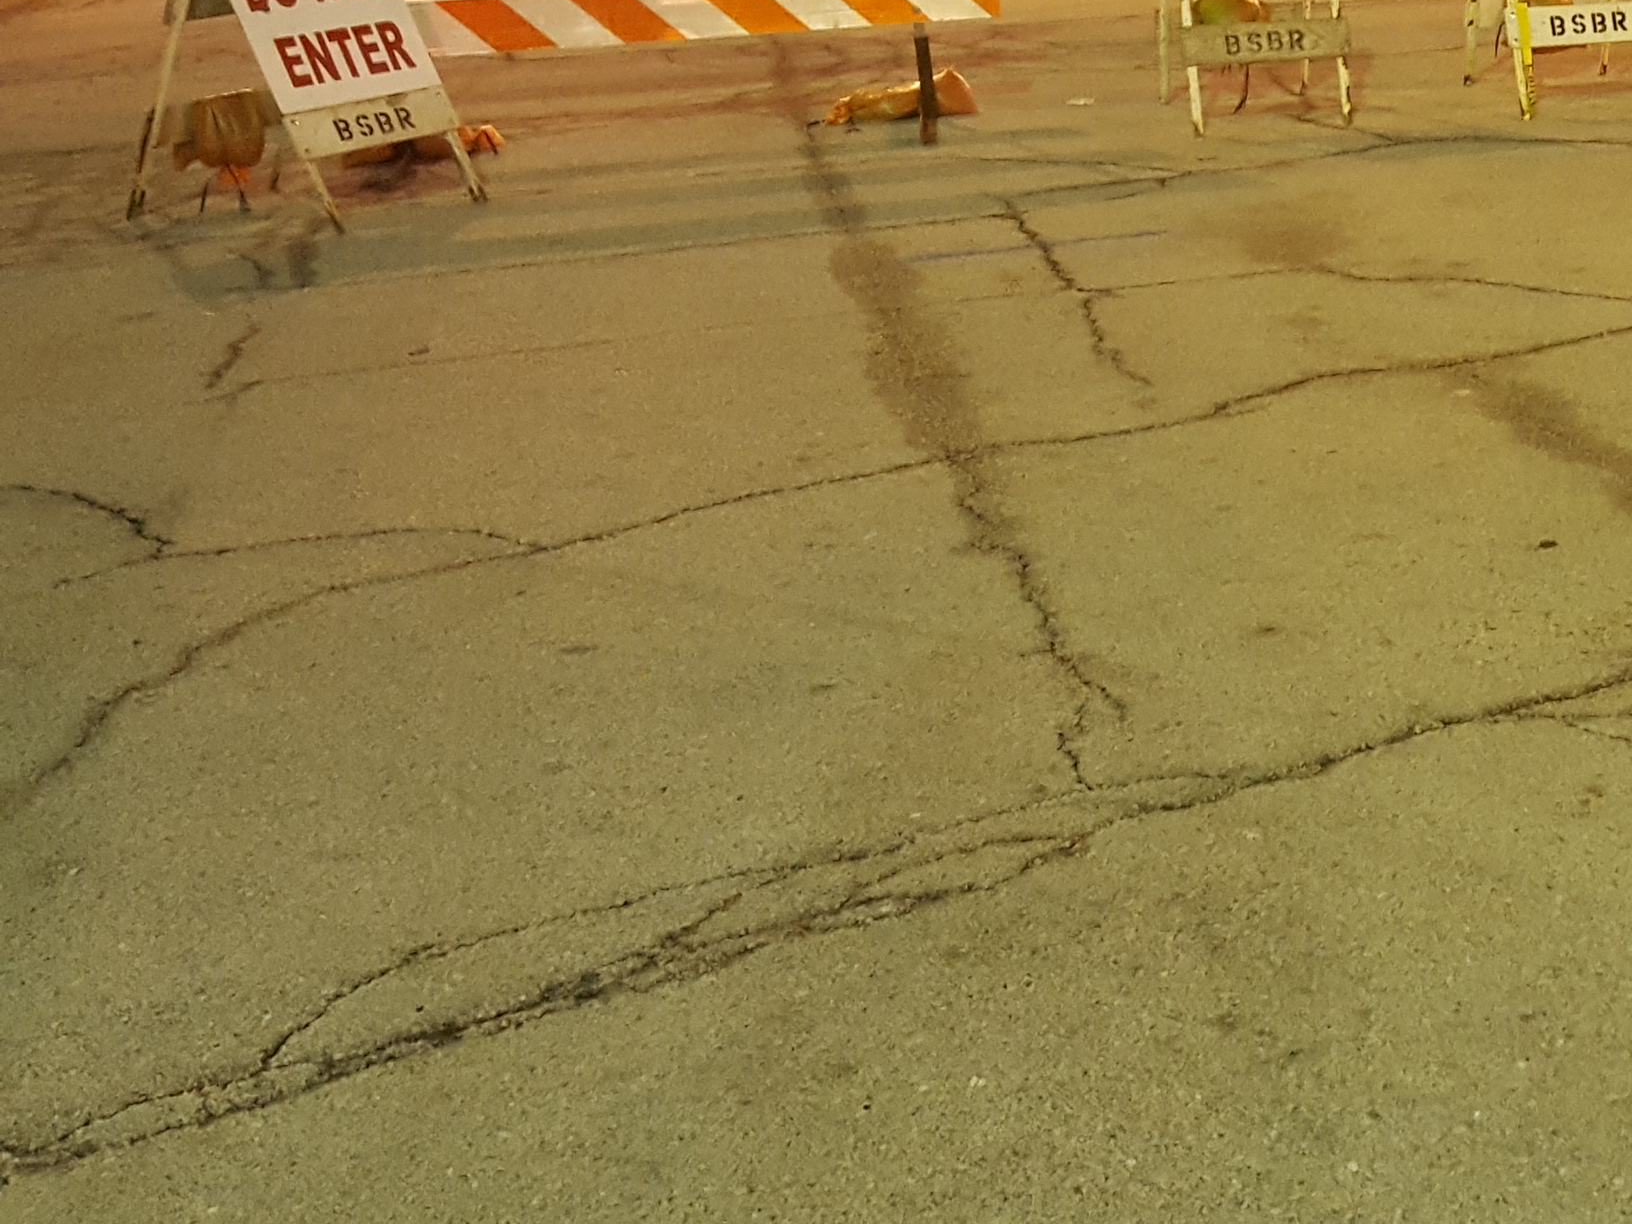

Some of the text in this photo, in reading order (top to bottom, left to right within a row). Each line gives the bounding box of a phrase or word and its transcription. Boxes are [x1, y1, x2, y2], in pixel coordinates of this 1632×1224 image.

[1550, 11, 1628, 36] BSBR
[273, 20, 417, 88] ENTER
[1224, 29, 1305, 56] BSBR
[332, 107, 416, 142] BSBR
